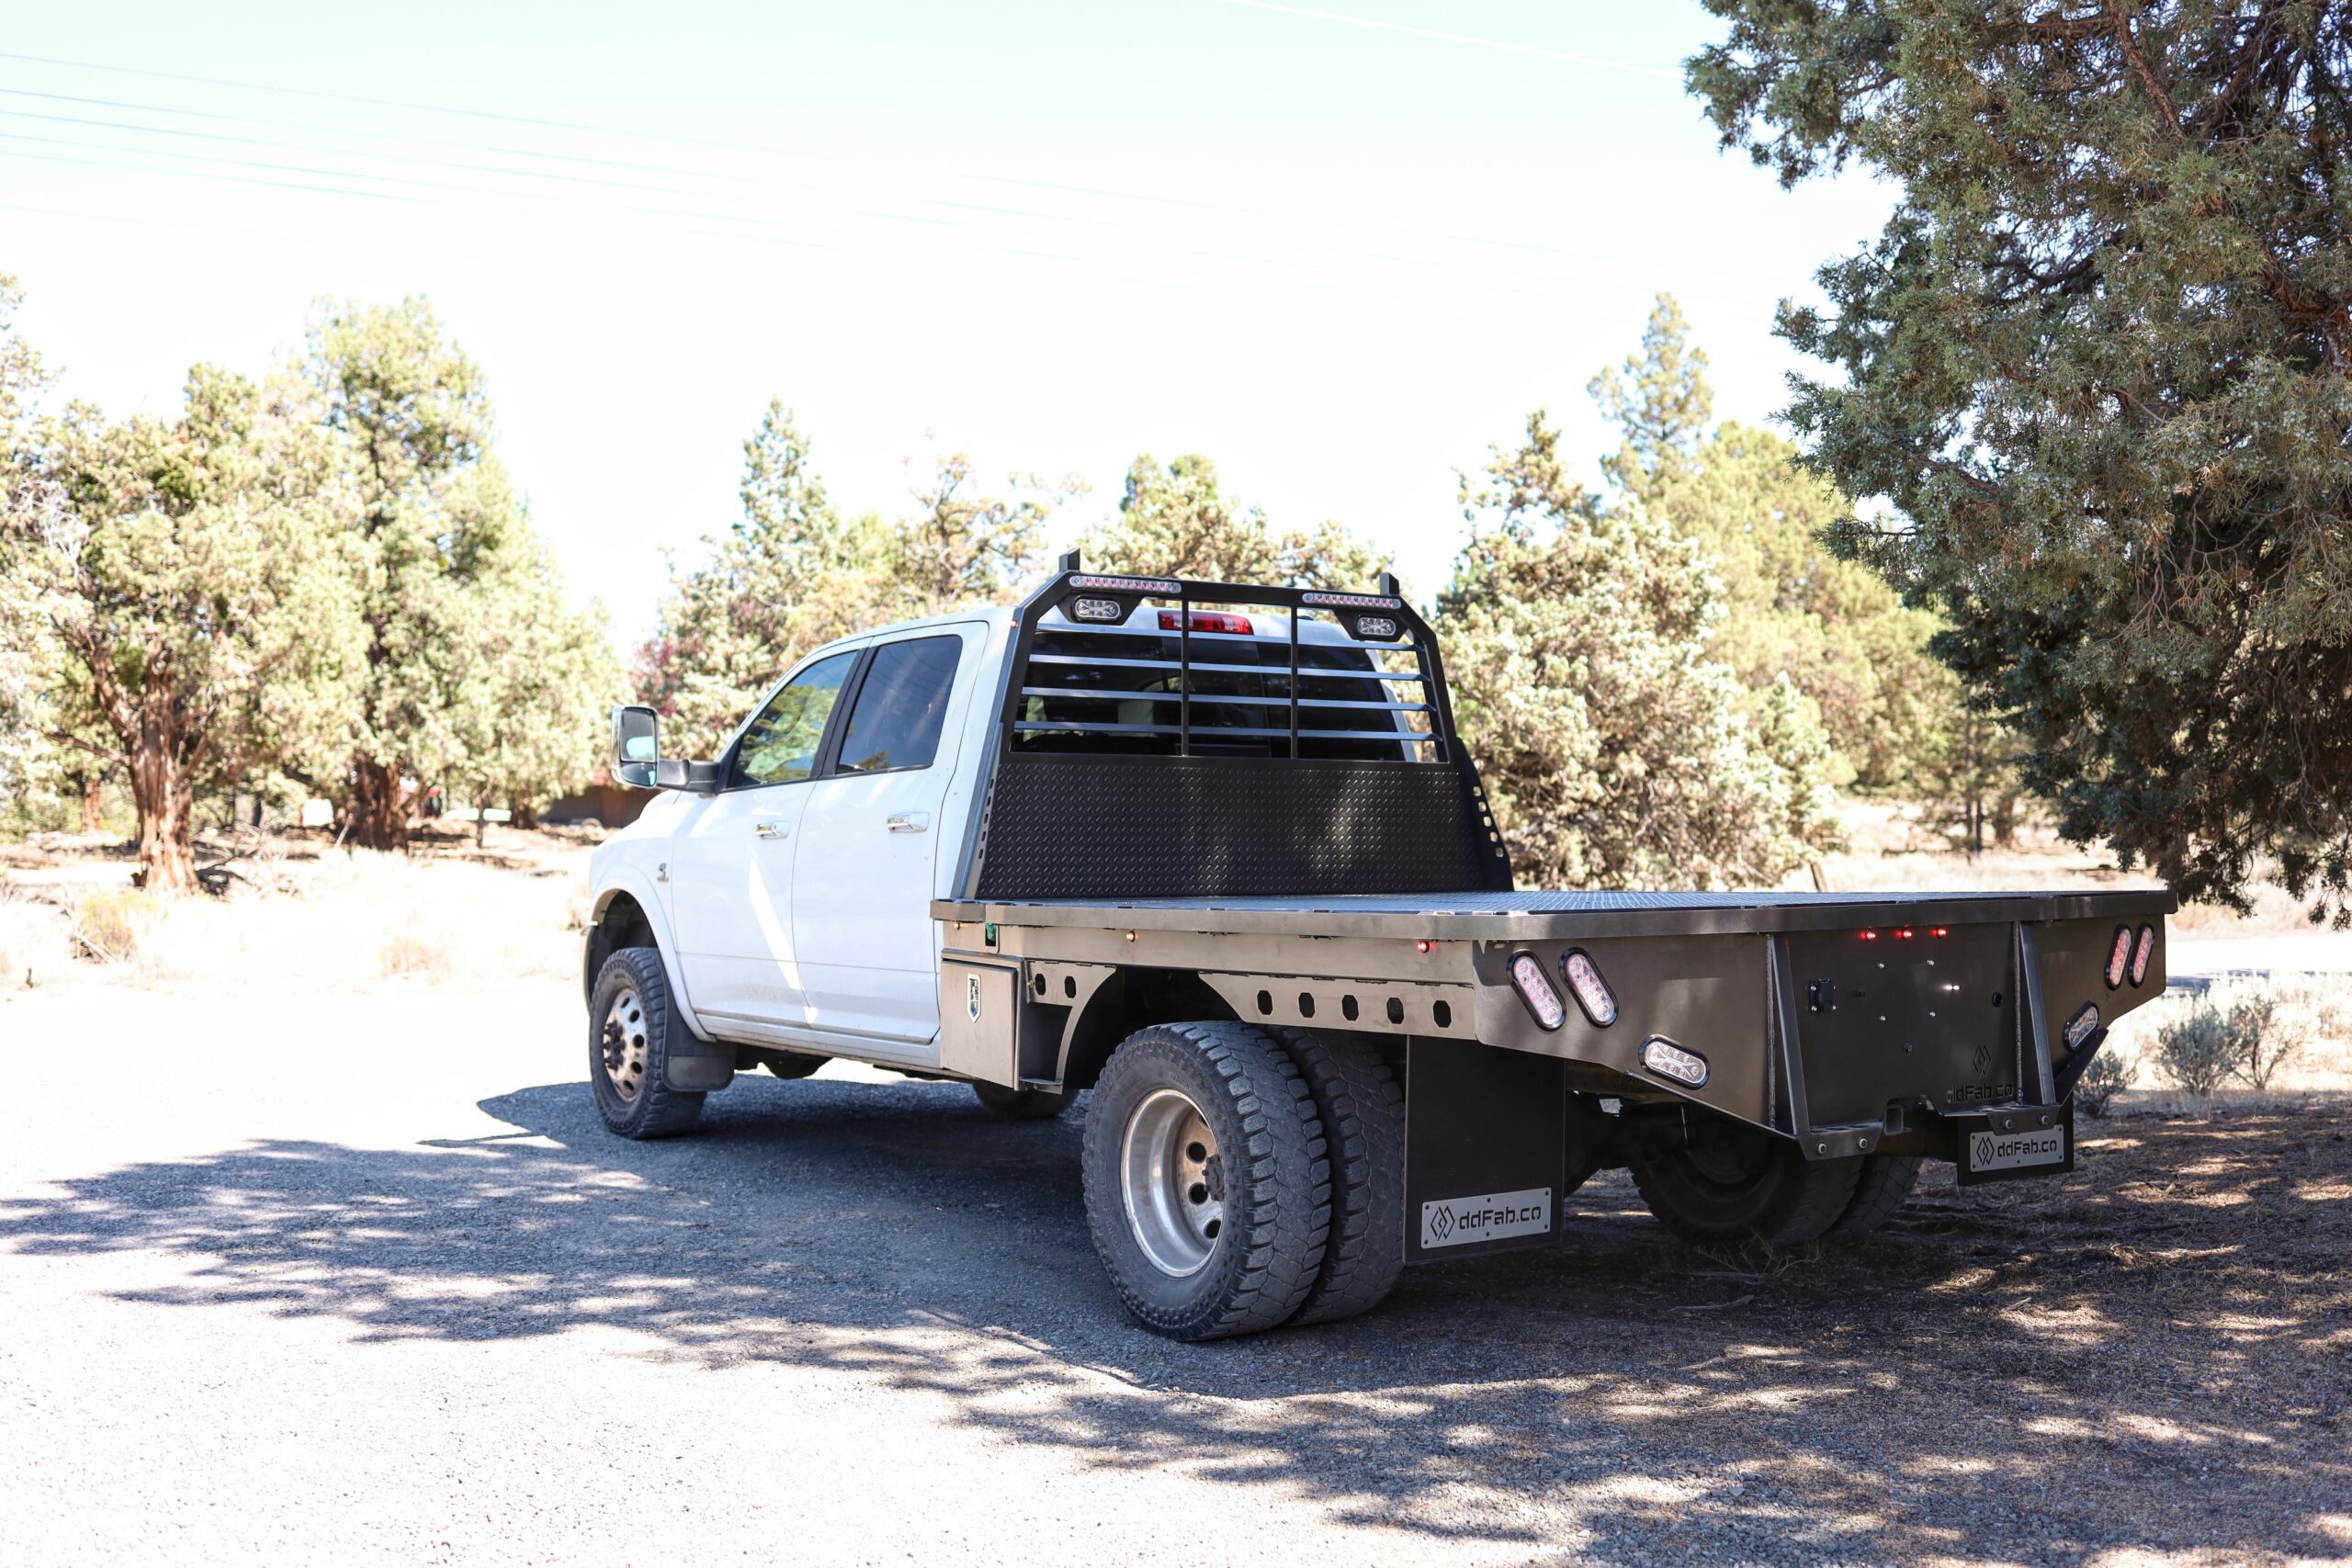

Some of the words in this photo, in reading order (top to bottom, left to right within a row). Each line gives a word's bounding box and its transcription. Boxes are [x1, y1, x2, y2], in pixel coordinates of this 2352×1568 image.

[1946, 1083, 2013, 1103] ddFab.co
[1996, 1139, 2057, 1157] ddFab.co
[1459, 1205, 1541, 1230] ddFab.co
